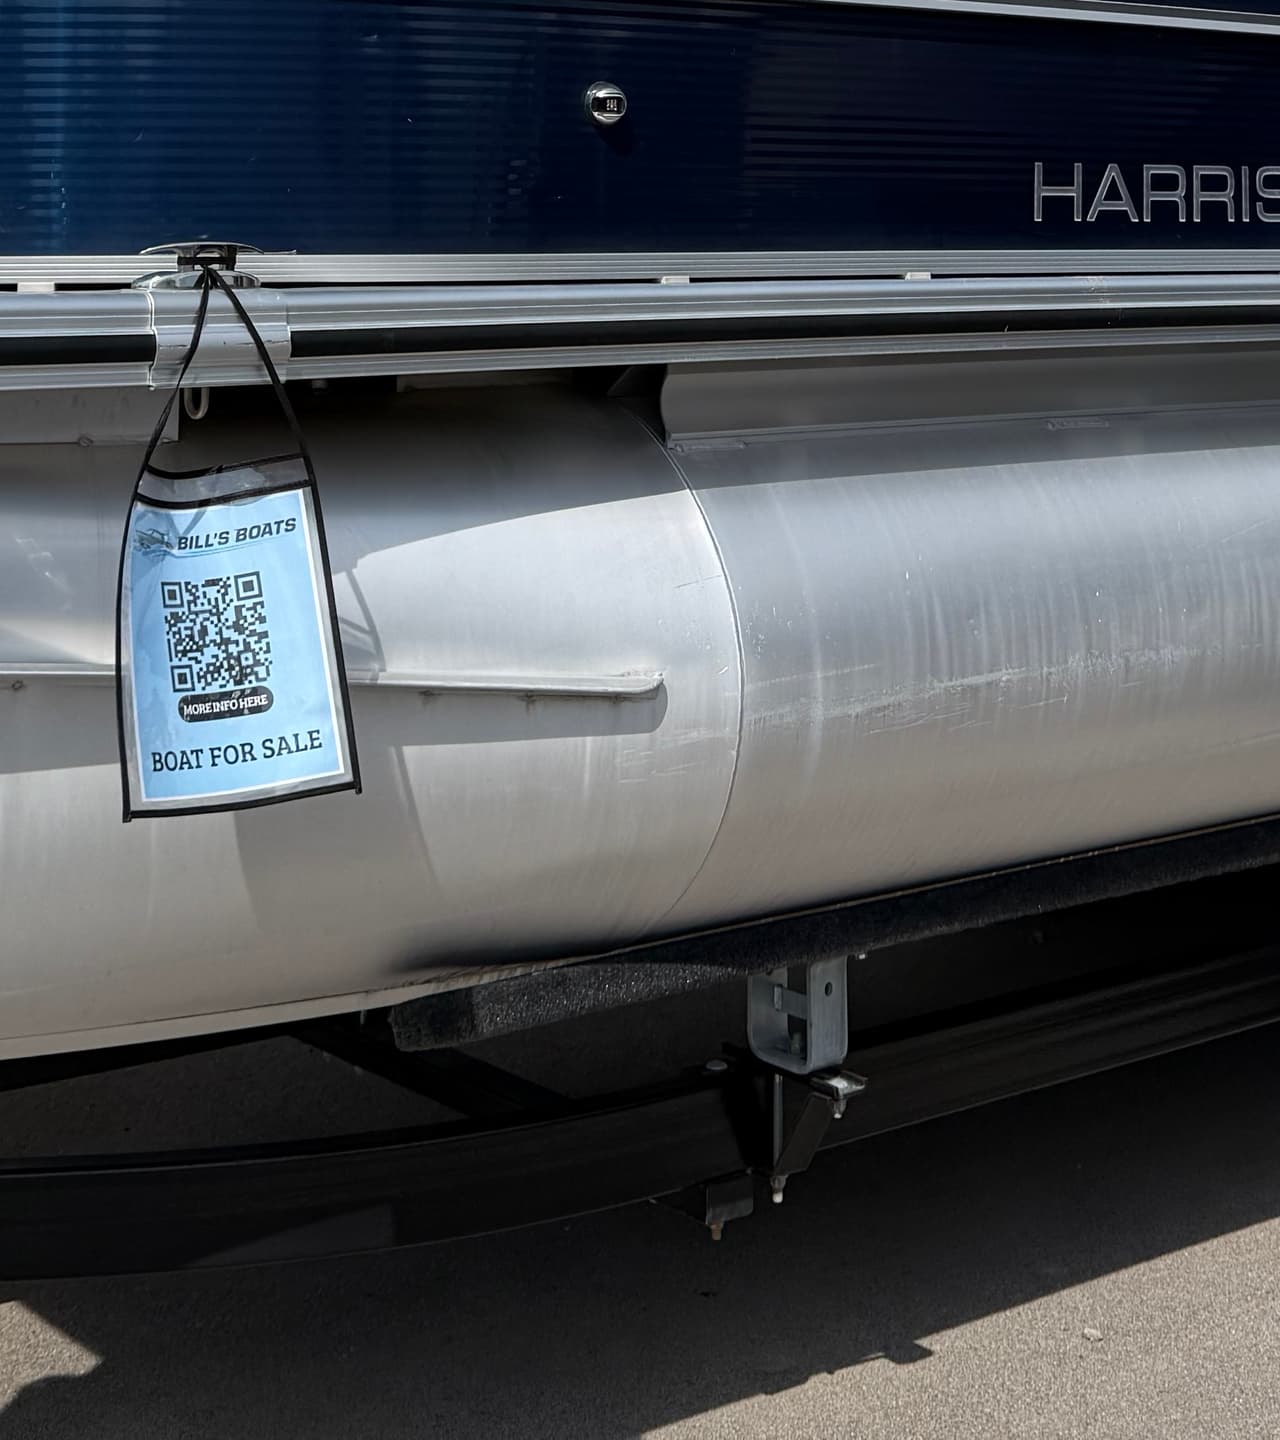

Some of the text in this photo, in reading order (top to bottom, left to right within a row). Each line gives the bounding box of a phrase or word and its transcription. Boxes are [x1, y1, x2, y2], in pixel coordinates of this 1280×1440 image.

[176, 517, 297, 551] BILL'S BOATS
[183, 694, 269, 716] MORE INFO HERE
[151, 728, 323, 773] BOAT FOR SALE
